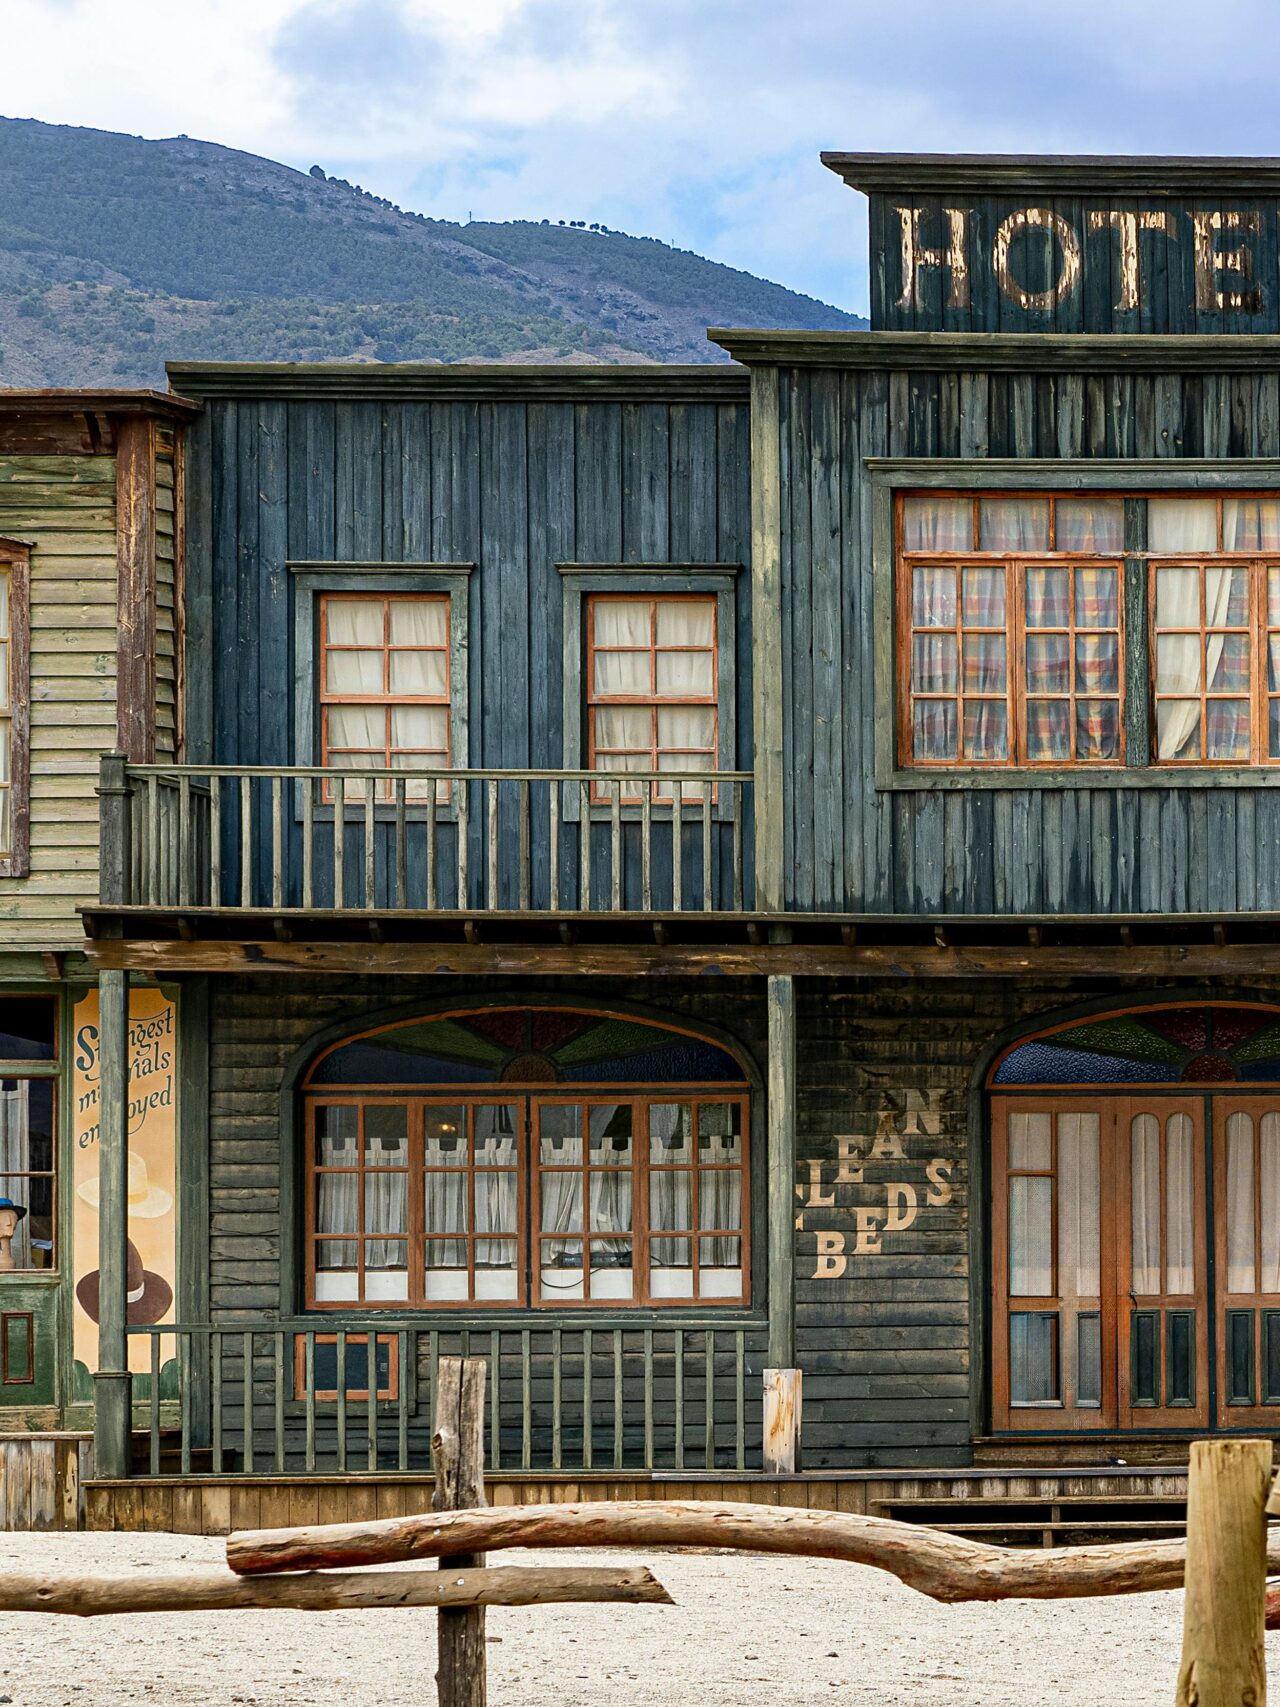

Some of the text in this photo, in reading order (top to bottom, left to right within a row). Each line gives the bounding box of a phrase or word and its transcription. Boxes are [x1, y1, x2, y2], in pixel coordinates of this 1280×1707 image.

[76, 1007, 173, 1078] Sngest
[79, 1041, 171, 1112] mrials
[795, 1088, 948, 1231] LEAN
[811, 1158, 952, 1279] BEDS
